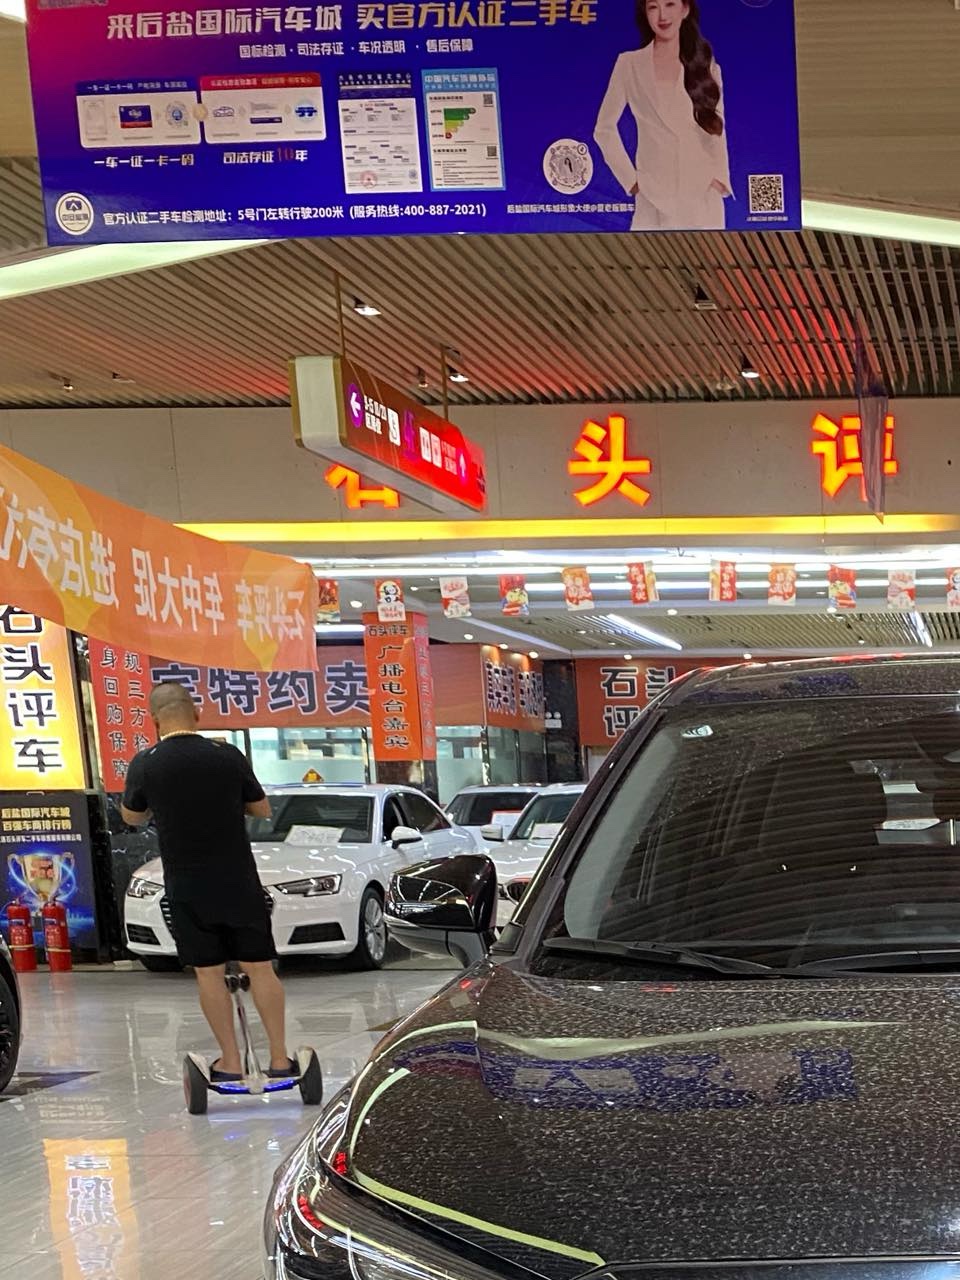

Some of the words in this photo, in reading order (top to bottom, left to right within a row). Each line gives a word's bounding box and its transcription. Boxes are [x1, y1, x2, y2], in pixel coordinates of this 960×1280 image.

[107, 5, 343, 39] 来后盐国际汽车城
[356, 0, 598, 30] 买官方认证二手车
[94, 153, 194, 168] 一车一证一卡一码
[223, 148, 308, 165] 司法存证10年
[378, 645, 409, 750] 广播电台嘉宾
